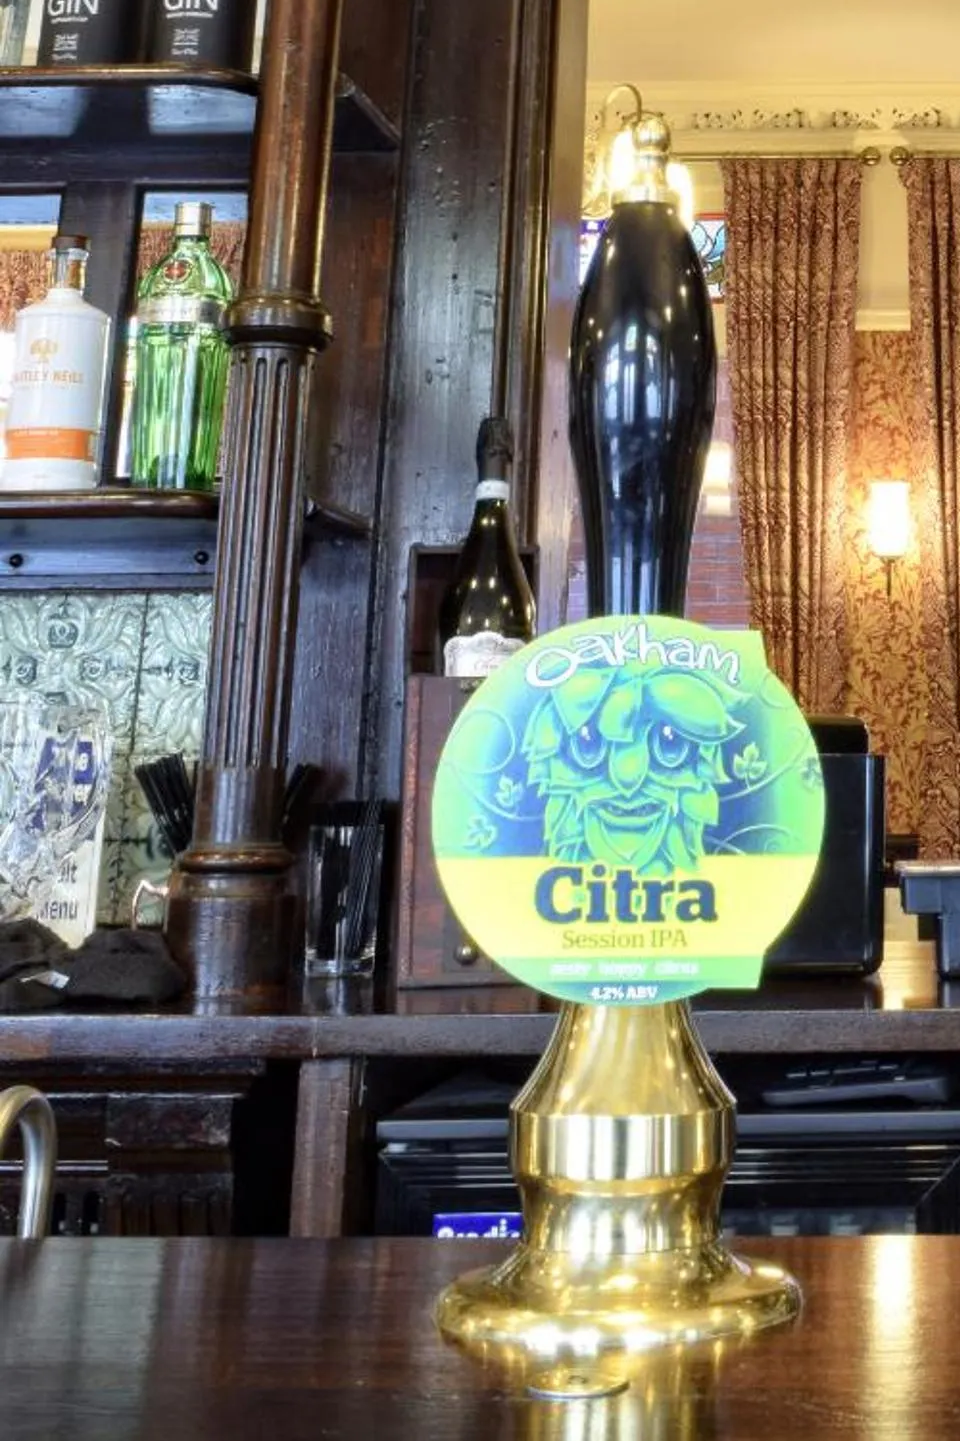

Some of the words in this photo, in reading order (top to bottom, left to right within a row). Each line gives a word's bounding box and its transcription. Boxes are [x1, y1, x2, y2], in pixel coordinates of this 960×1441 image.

[525, 621, 740, 688] Oakham
[534, 863, 719, 924] Citra
[561, 929, 645, 950] Session
[649, 928, 688, 949] IPA
[590, 985, 624, 1001] 4.2%
[625, 984, 659, 1000] ABV
